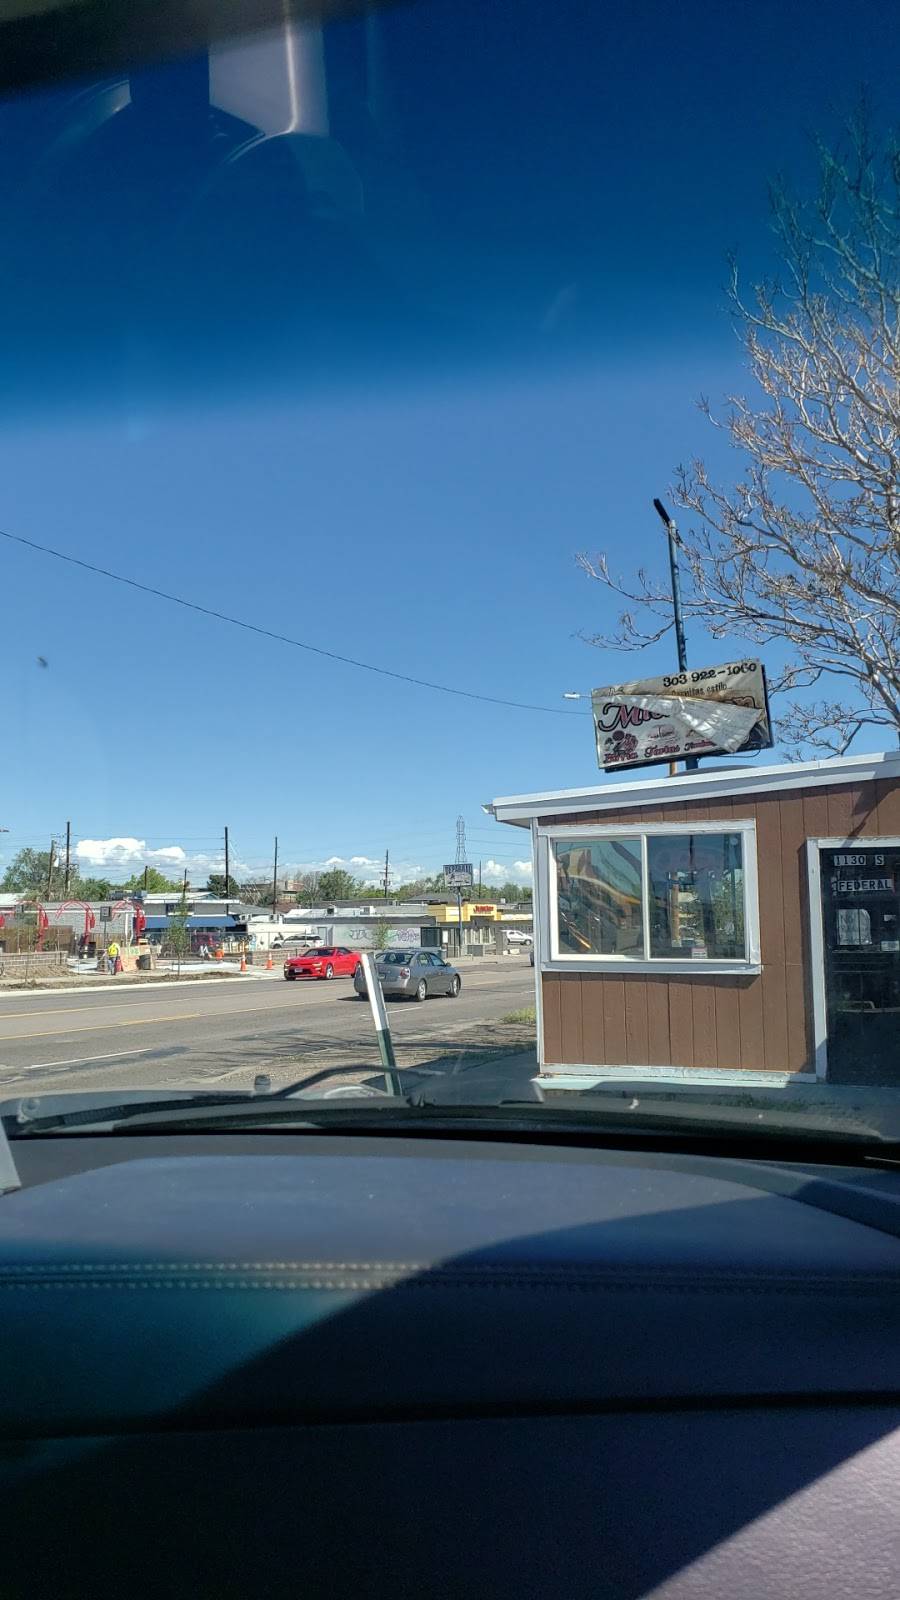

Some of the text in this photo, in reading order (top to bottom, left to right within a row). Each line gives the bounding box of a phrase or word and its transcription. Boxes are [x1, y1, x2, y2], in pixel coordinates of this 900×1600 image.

[663, 662, 757, 688] 303 922-1060
[836, 855, 884, 865] 1130 S
[839, 880, 892, 891] FEDERAL
